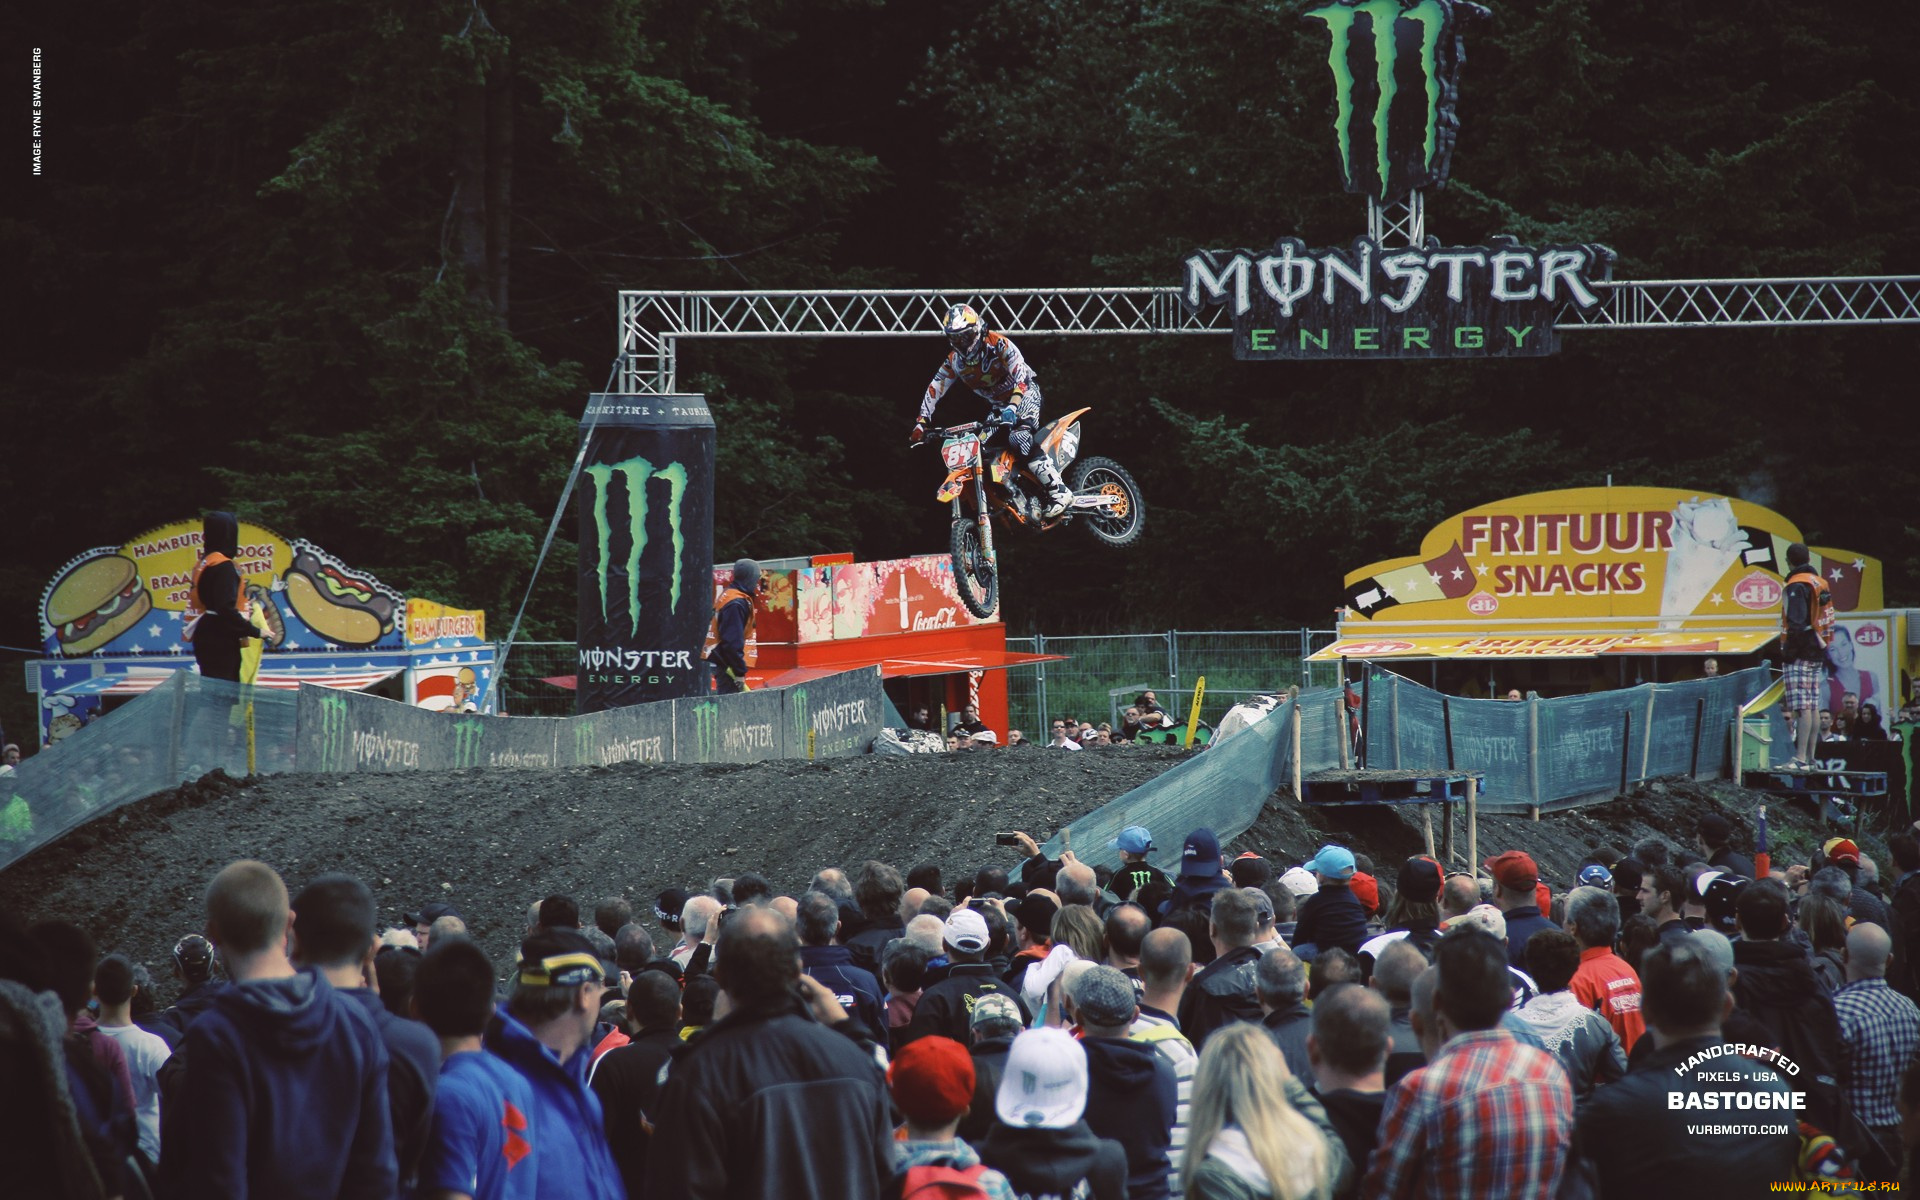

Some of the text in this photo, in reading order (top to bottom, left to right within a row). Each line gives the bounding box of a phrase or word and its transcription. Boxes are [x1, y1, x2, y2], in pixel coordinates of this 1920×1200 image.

[1185, 241, 1600, 318] MONSTER
[1251, 325, 1535, 351] ENERGY
[946, 441, 975, 468] 84
[1462, 510, 1675, 557] FRITUUR
[1494, 562, 1646, 597] SNACKS
[413, 615, 476, 640] HAMBURGERS
[578, 646, 694, 672] MONSTER
[588, 675, 675, 685] ENERGY
[812, 699, 867, 737] MONSTER
[352, 727, 419, 768] MONSTER
[601, 735, 662, 765] MONSTER
[723, 721, 774, 754] MONSTER
[822, 736, 859, 756] ENERGY
